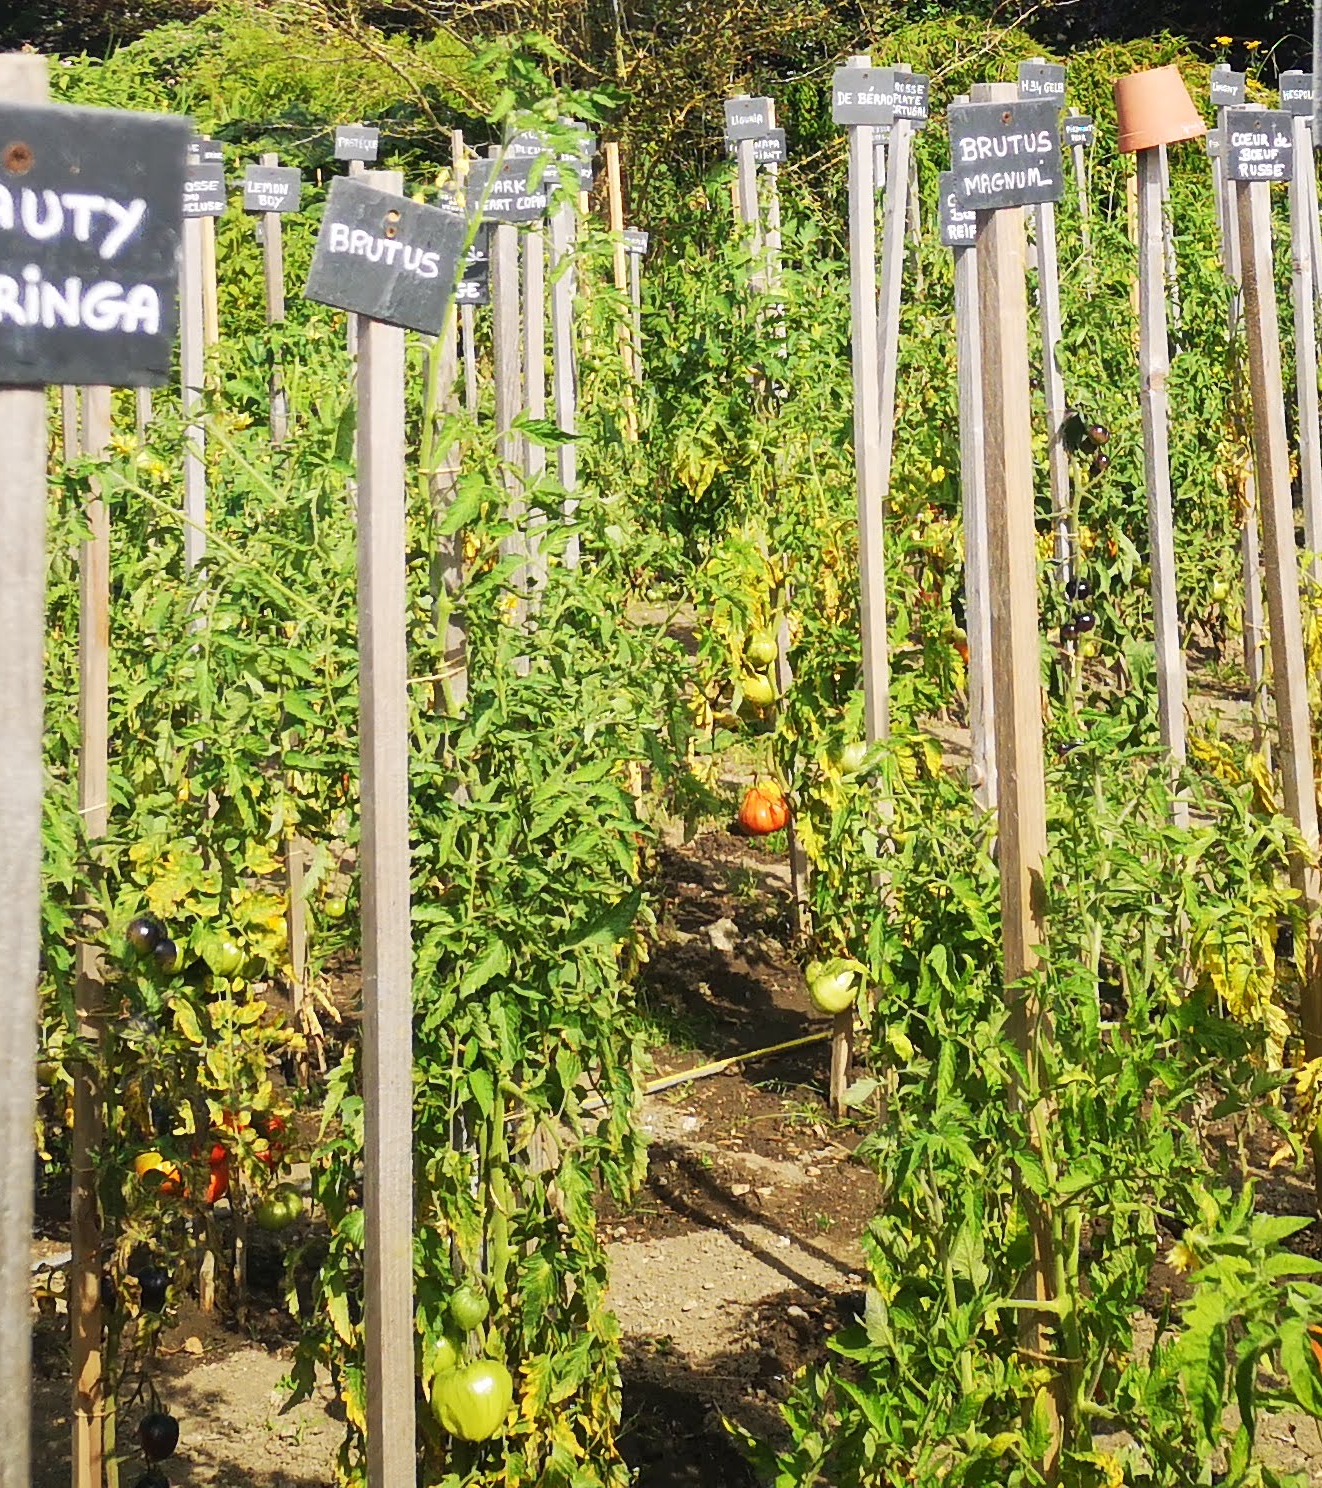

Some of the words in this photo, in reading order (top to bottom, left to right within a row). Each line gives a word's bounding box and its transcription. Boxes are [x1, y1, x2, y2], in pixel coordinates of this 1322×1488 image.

[837, 92, 852, 105] DE
[959, 131, 1053, 162] BRUTUS
[1239, 163, 1285, 178] RUSSE
[184, 180, 219, 192] OSSE
[963, 165, 1053, 196] MAGNUM
[248, 181, 289, 195] LEMON
[258, 195, 284, 209] BOY
[329, 222, 441, 279] BRUTUS
